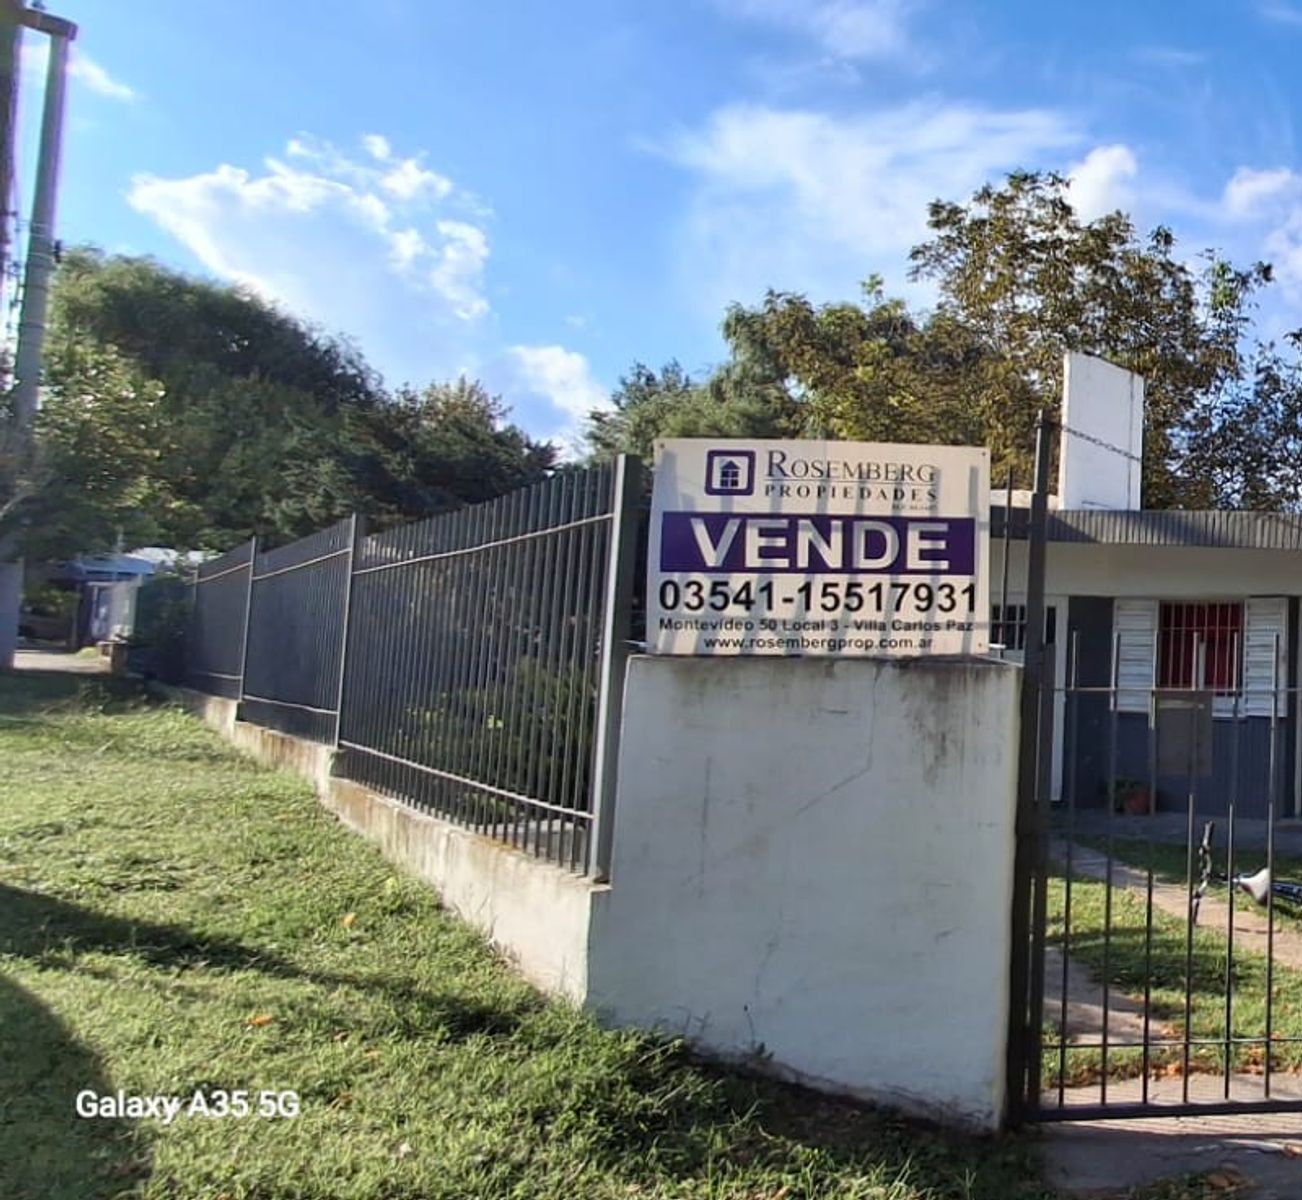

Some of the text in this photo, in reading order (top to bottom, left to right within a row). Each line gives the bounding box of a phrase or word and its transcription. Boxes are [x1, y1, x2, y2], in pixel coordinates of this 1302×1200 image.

[766, 450, 937, 482] ROSEMBERG
[765, 484, 938, 501] PROPIEDADES
[690, 517, 950, 571] VENDE
[659, 579, 976, 613] 03541-15517931
[659, 617, 755, 631] Montevideo
[759, 619, 778, 631] 50
[782, 619, 825, 632] Local
[829, 619, 839, 631] 3
[854, 619, 887, 631] Villa
[891, 619, 941, 632] Carlos
[945, 620, 974, 632] Paz
[704, 636, 933, 651] www.rosembergprop.com.ar
